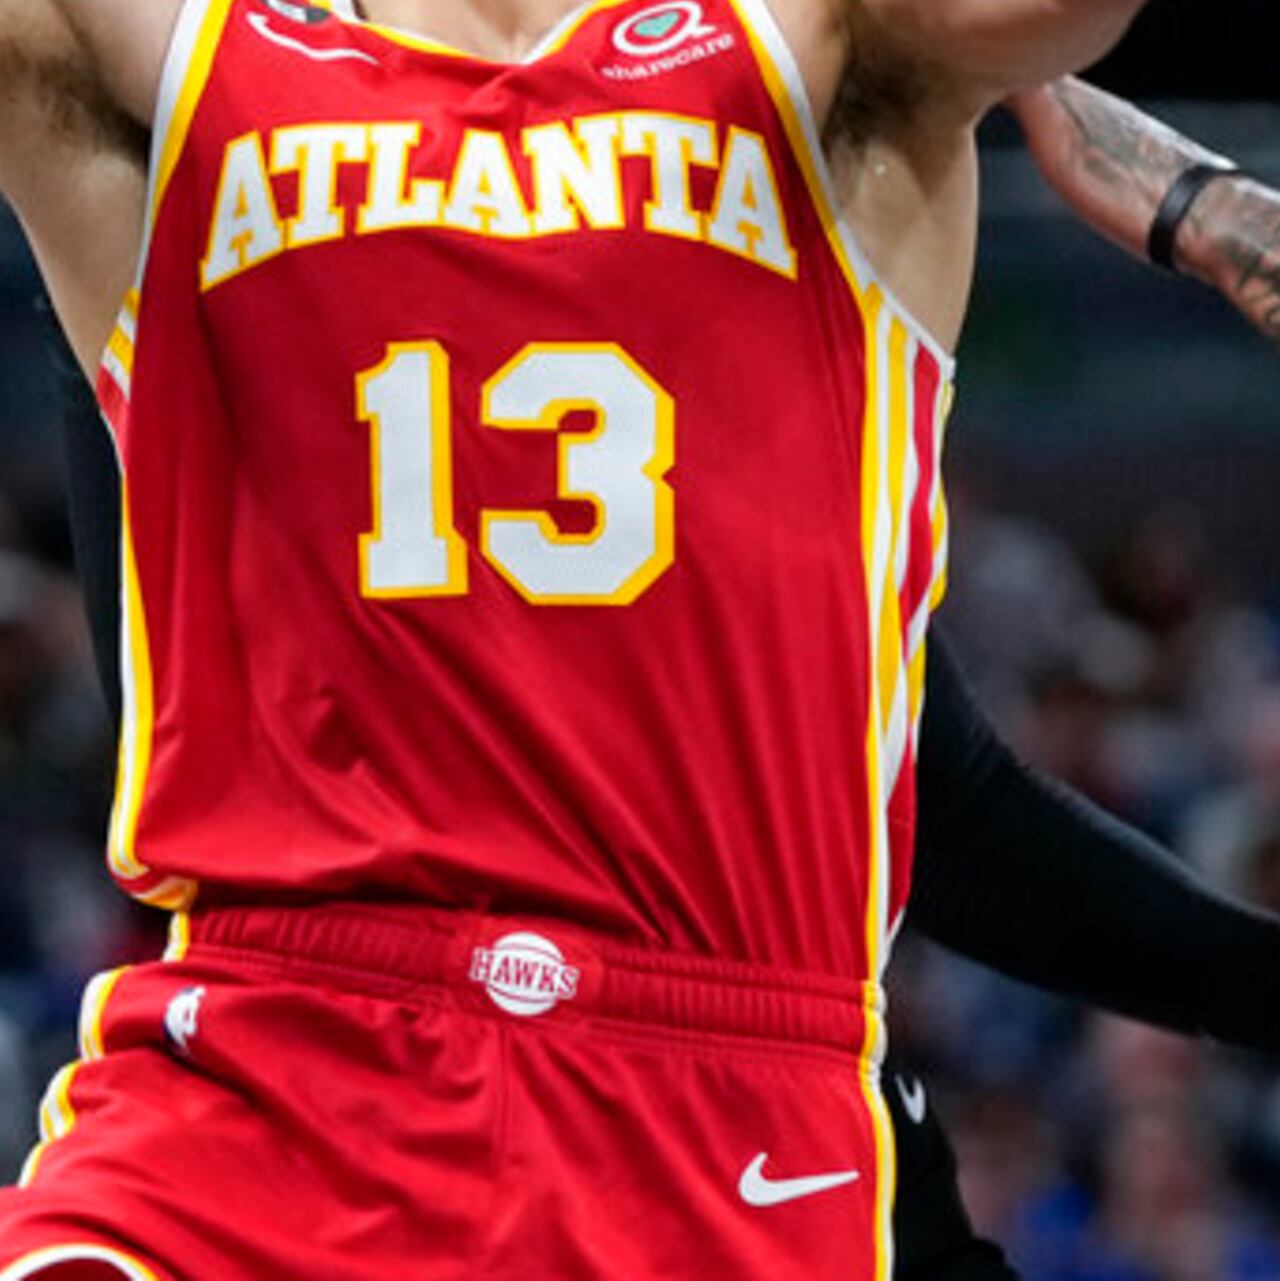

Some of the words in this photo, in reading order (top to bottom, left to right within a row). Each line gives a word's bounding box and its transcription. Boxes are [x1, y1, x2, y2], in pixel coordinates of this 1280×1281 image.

[200, 110, 798, 293] ATLANTA
[355, 339, 676, 607] 13
[469, 946, 582, 1000] HAWKS
